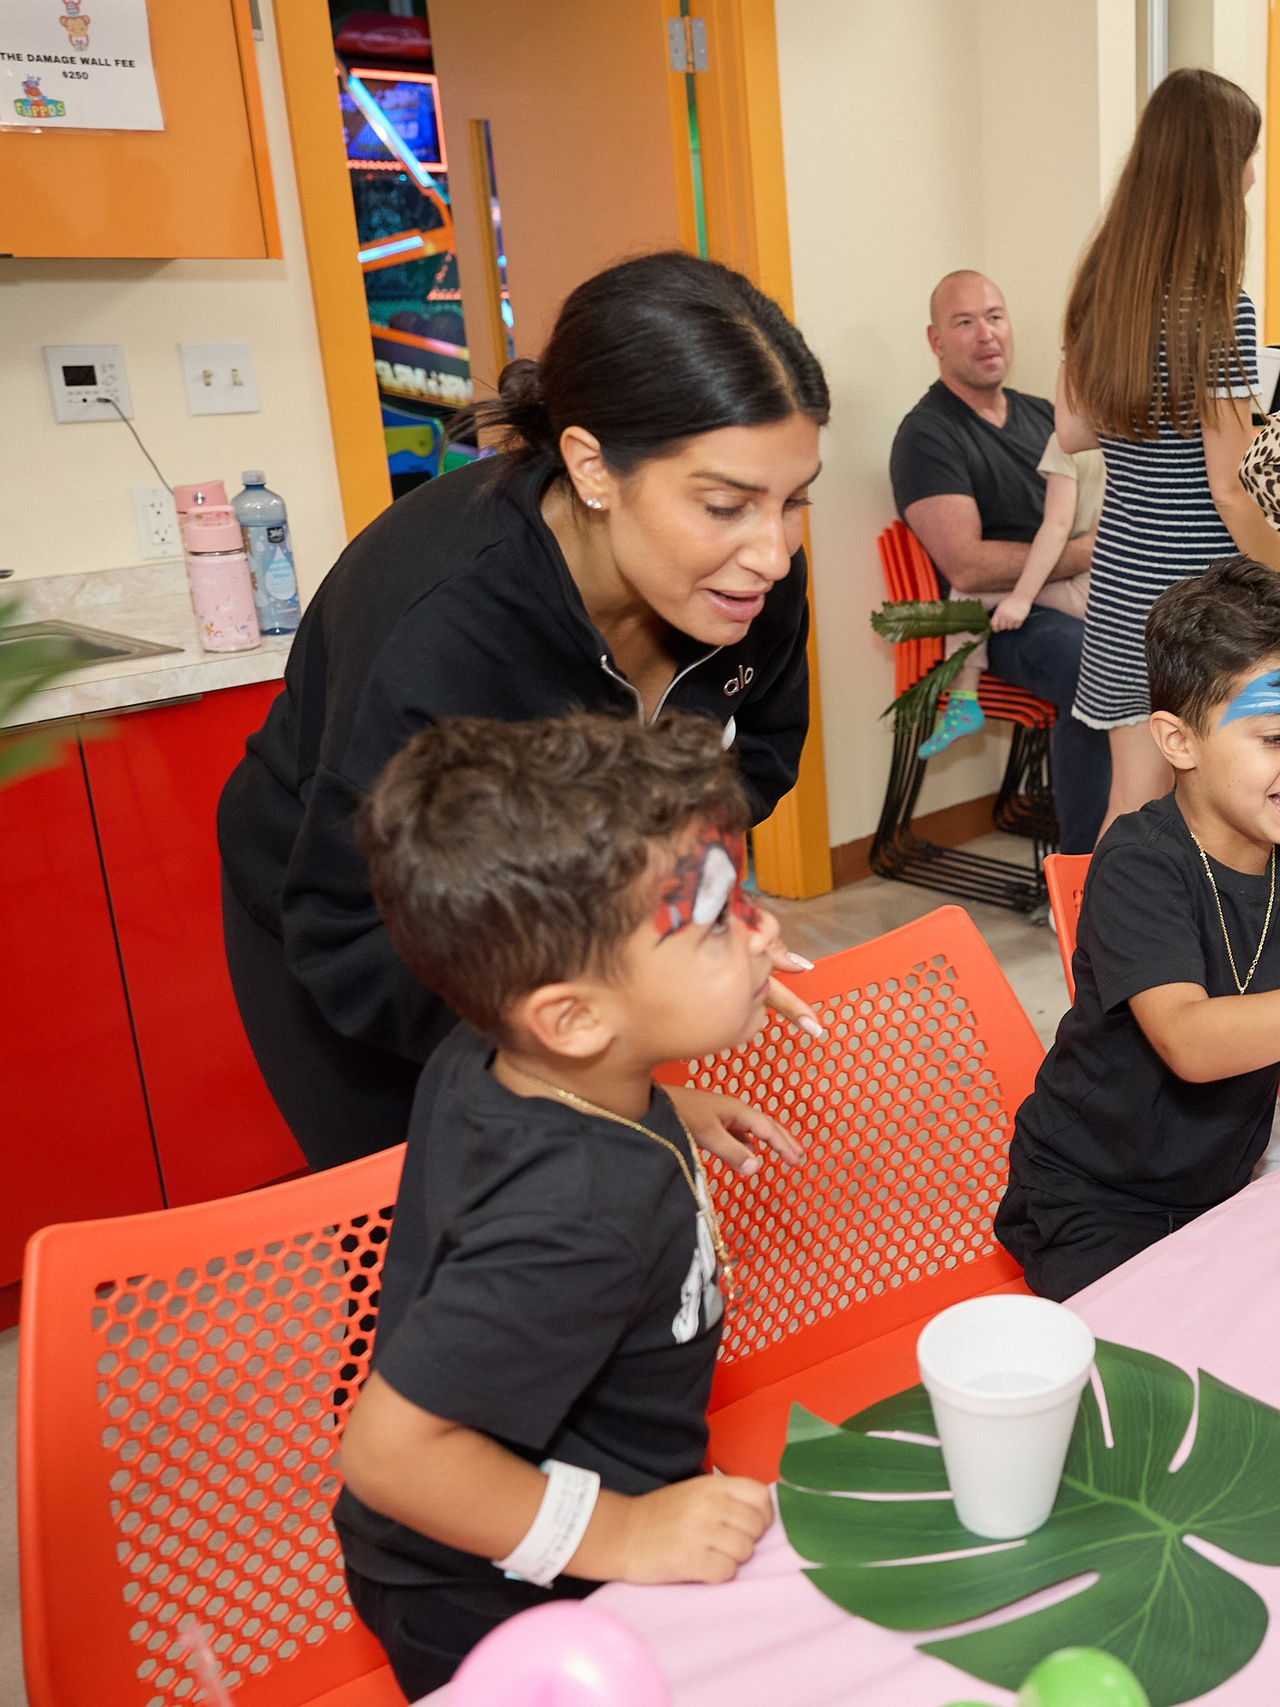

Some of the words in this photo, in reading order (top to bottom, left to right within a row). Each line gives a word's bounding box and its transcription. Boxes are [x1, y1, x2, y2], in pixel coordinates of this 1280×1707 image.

[0, 52, 23, 61] THE
[27, 54, 76, 64] DAMAGE
[79, 57, 112, 67] WALL
[114, 59, 136, 68] FEE
[62, 71, 89, 80] $250
[723, 664, 754, 697] alo
